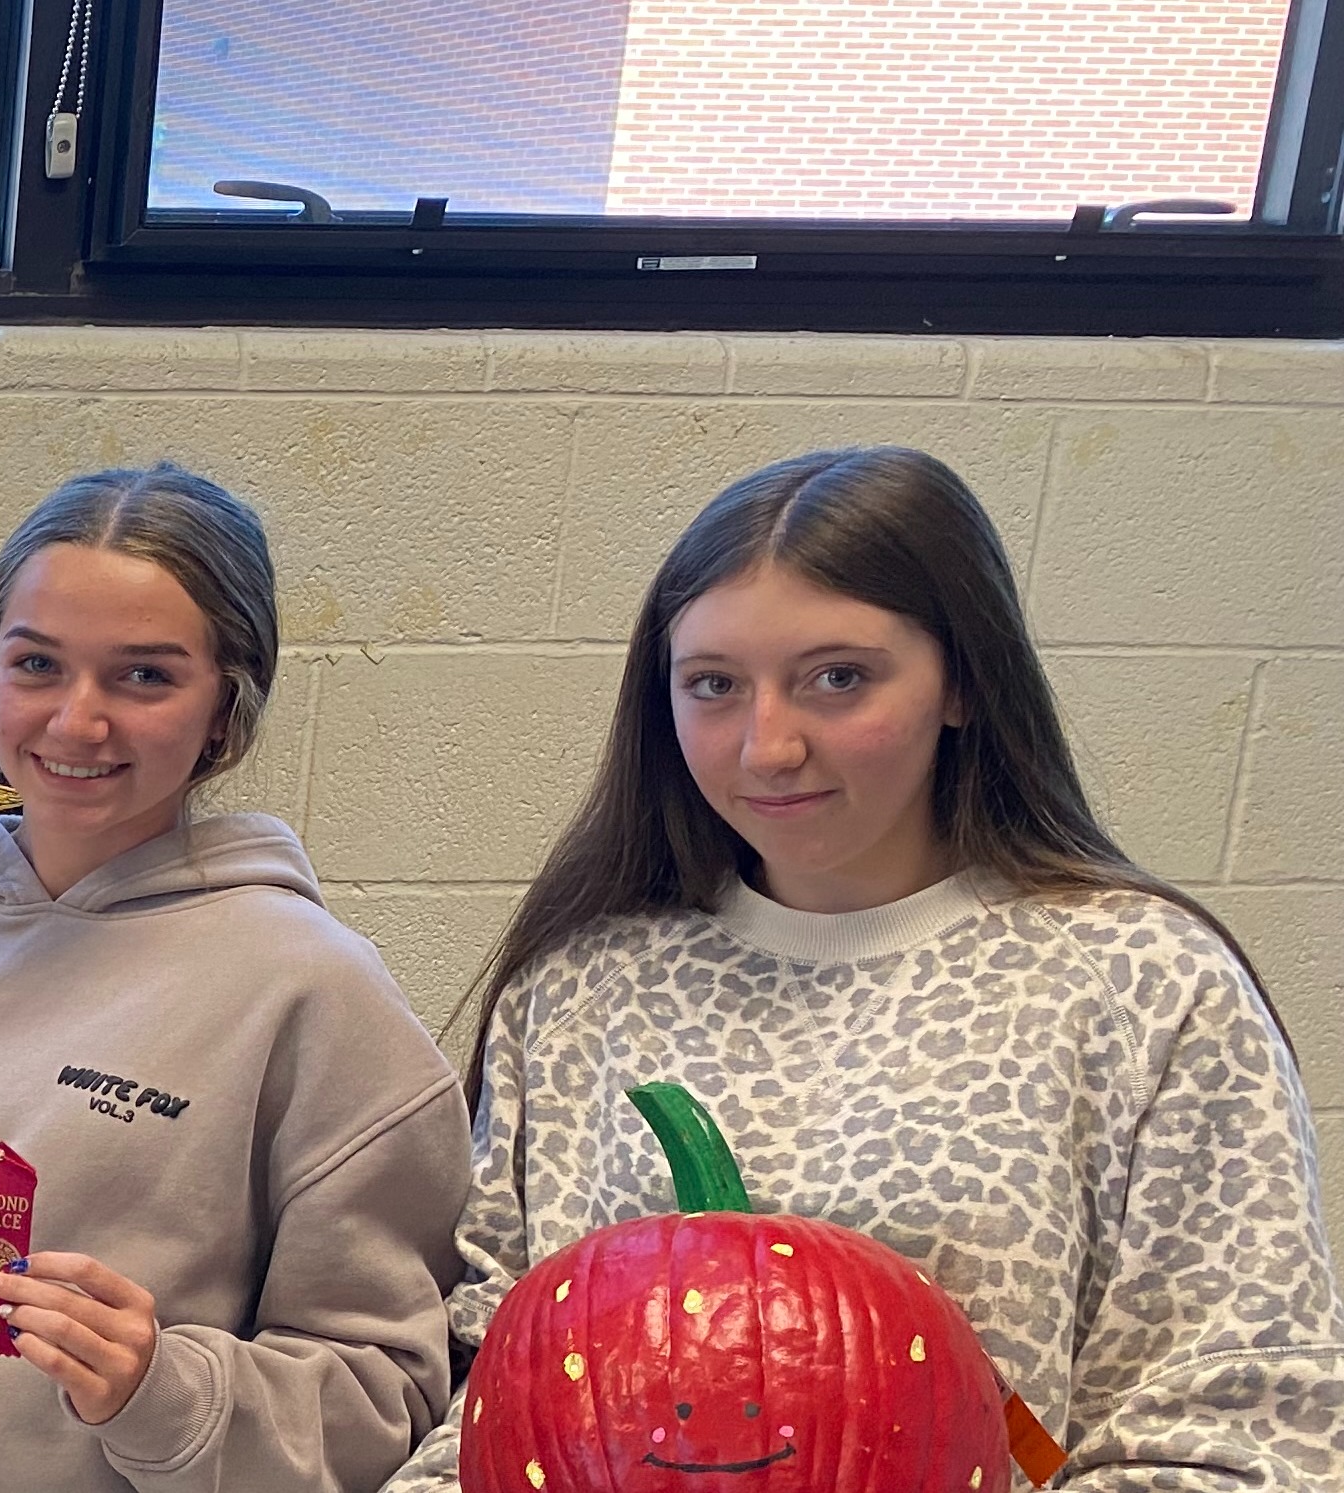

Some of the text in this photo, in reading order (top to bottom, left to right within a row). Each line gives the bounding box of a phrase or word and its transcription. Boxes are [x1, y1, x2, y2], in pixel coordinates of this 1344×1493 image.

[57, 1065, 190, 1119] WHITE FOX
[89, 1096, 135, 1123] VOL.3
